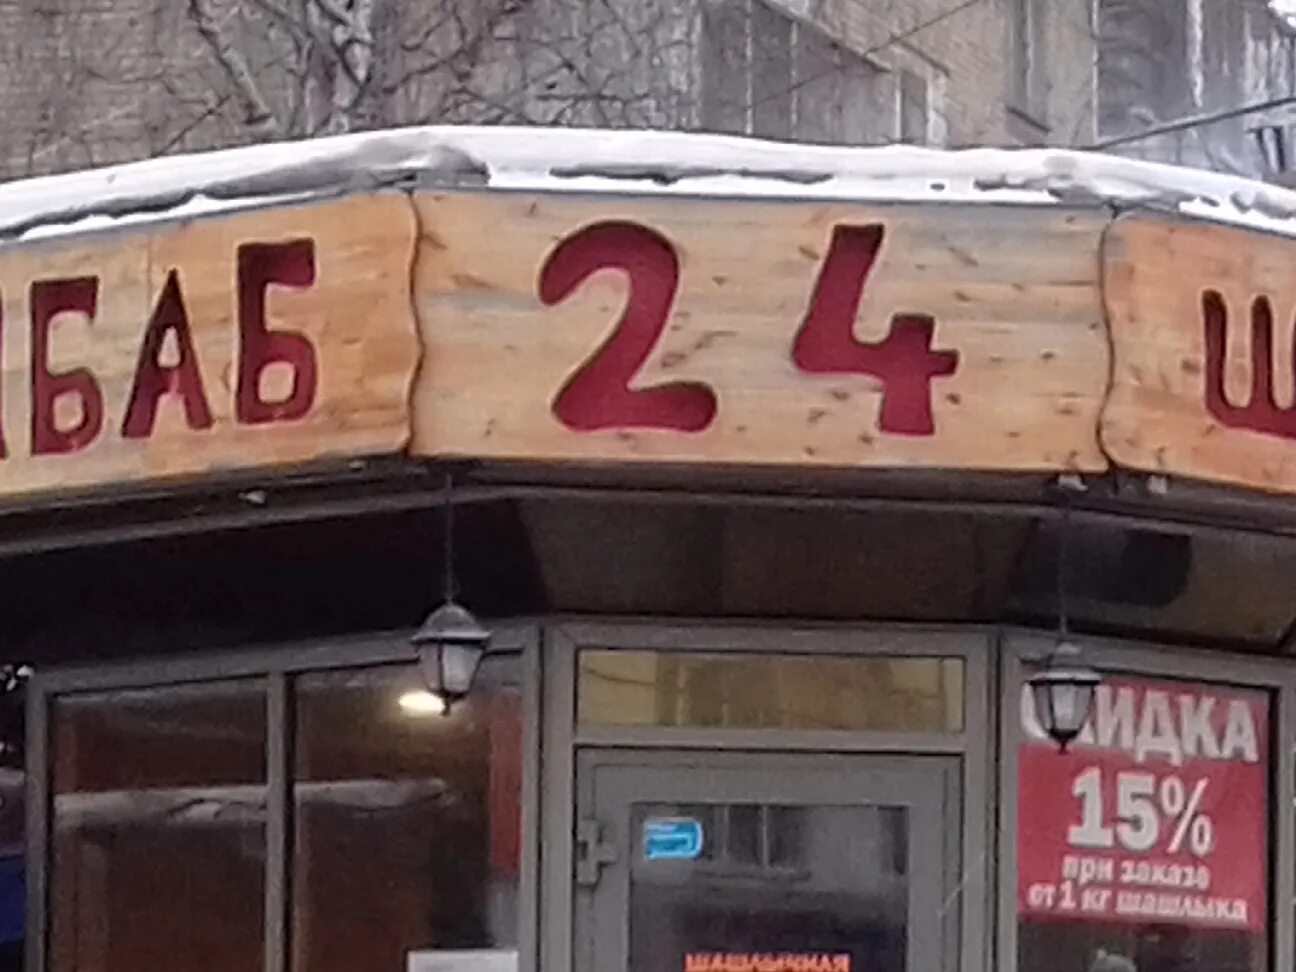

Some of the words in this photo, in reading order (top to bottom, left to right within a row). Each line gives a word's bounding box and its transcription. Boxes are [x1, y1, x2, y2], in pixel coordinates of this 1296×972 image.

[0, 236, 318, 459] БАБ
[538, 219, 958, 436] 24
[1020, 681, 1260, 767] ИДКА
[1066, 765, 1214, 857] 15%
[1027, 882, 1056, 909] от
[1060, 879, 1077, 911] 1
[1081, 888, 1112, 913] кг
[1115, 890, 1249, 922] шашлыка
[1062, 855, 1114, 884] при
[1119, 860, 1210, 891] заказе
